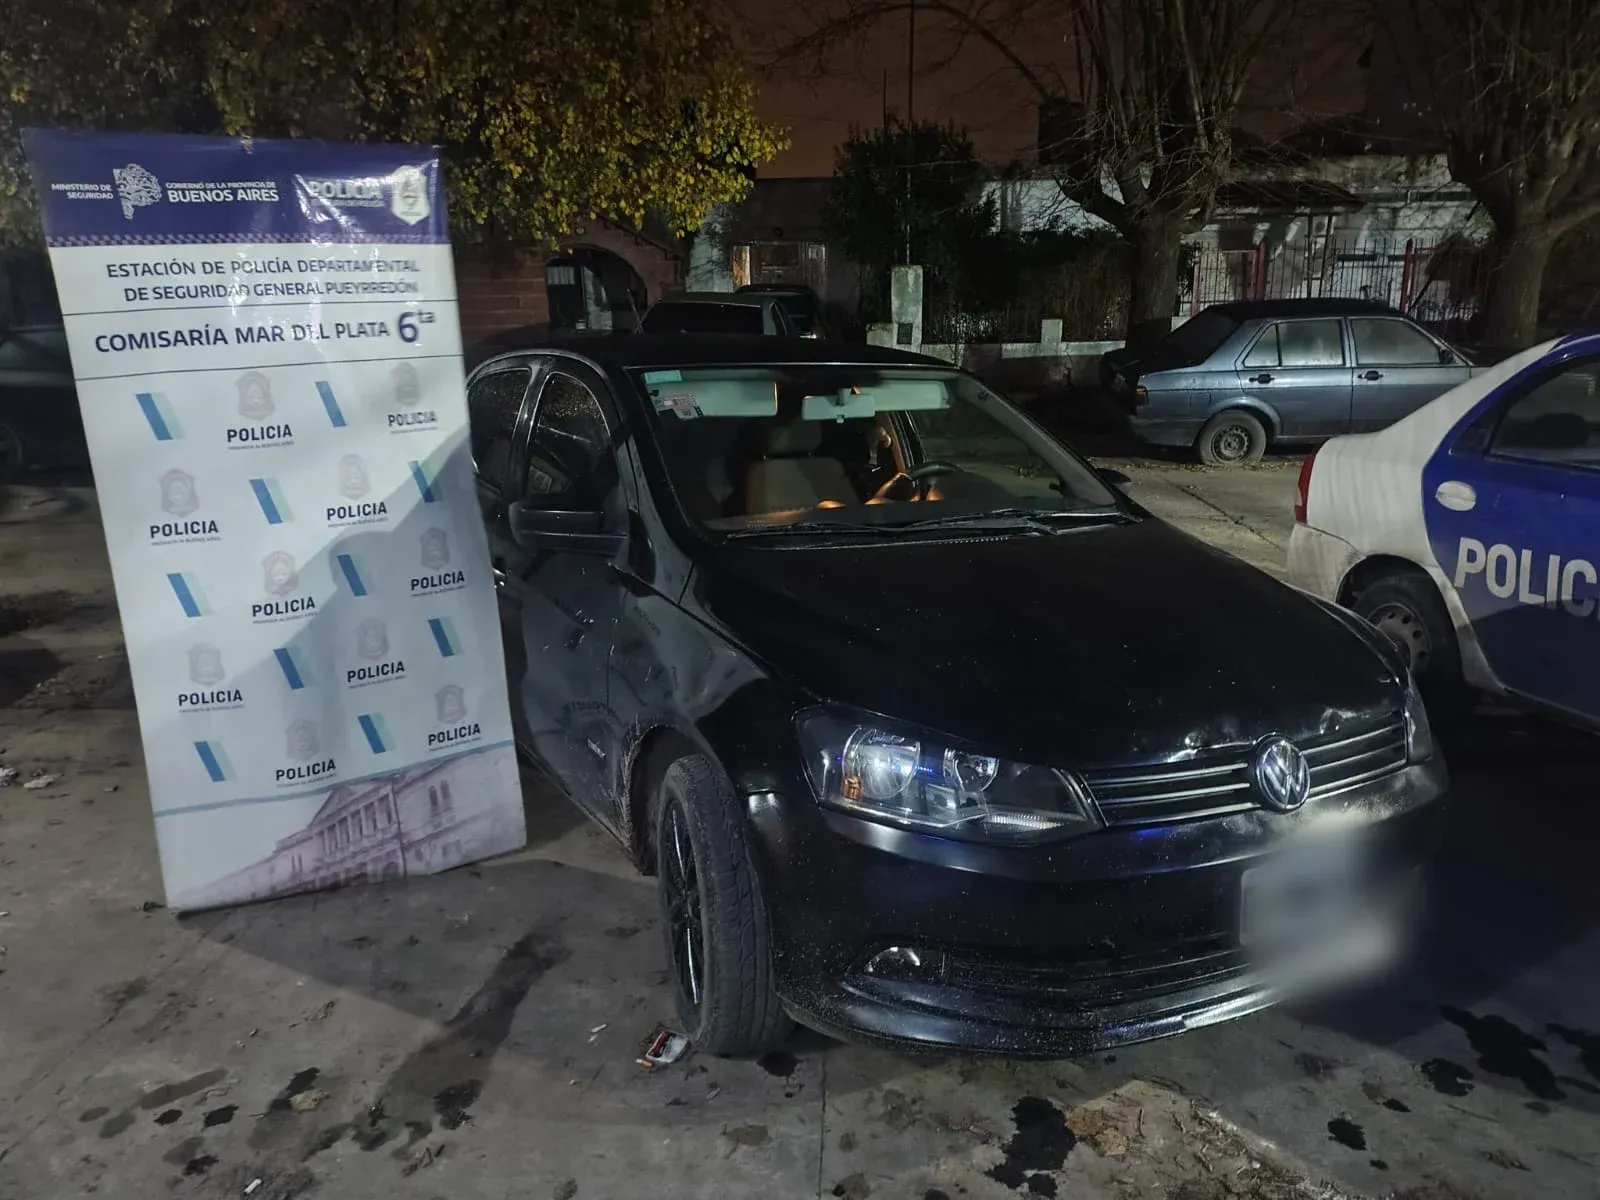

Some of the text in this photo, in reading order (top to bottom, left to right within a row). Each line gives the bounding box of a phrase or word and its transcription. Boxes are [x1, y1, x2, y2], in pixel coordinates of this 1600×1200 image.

[51, 183, 113, 192] MINISTERIO DE
[66, 191, 114, 200] SEGURIDAD
[167, 188, 280, 202] BUENOS AIRES
[106, 256, 420, 278] ESTACIÓN DE POLICÍA DEPARTAMENTAL
[124, 287, 149, 302] DE
[152, 284, 249, 300] SEGURIDAD
[253, 280, 324, 297] GENERAL
[94, 323, 229, 353] COMISARÍA
[234, 324, 285, 345] MAR
[335, 321, 391, 340] PLATA
[388, 411, 438, 428] POLICIA
[226, 423, 293, 443] POLICIA
[326, 501, 388, 521] POLICIA
[149, 520, 219, 539] POLICIA
[410, 570, 464, 591] POLICIA
[1454, 536, 1600, 620] POLIC
[251, 596, 316, 617] POLICIA
[346, 660, 406, 683] POLICIA
[178, 688, 244, 707] POLICIA
[427, 723, 481, 746] POLICIA
[275, 757, 337, 781] POLICIA
